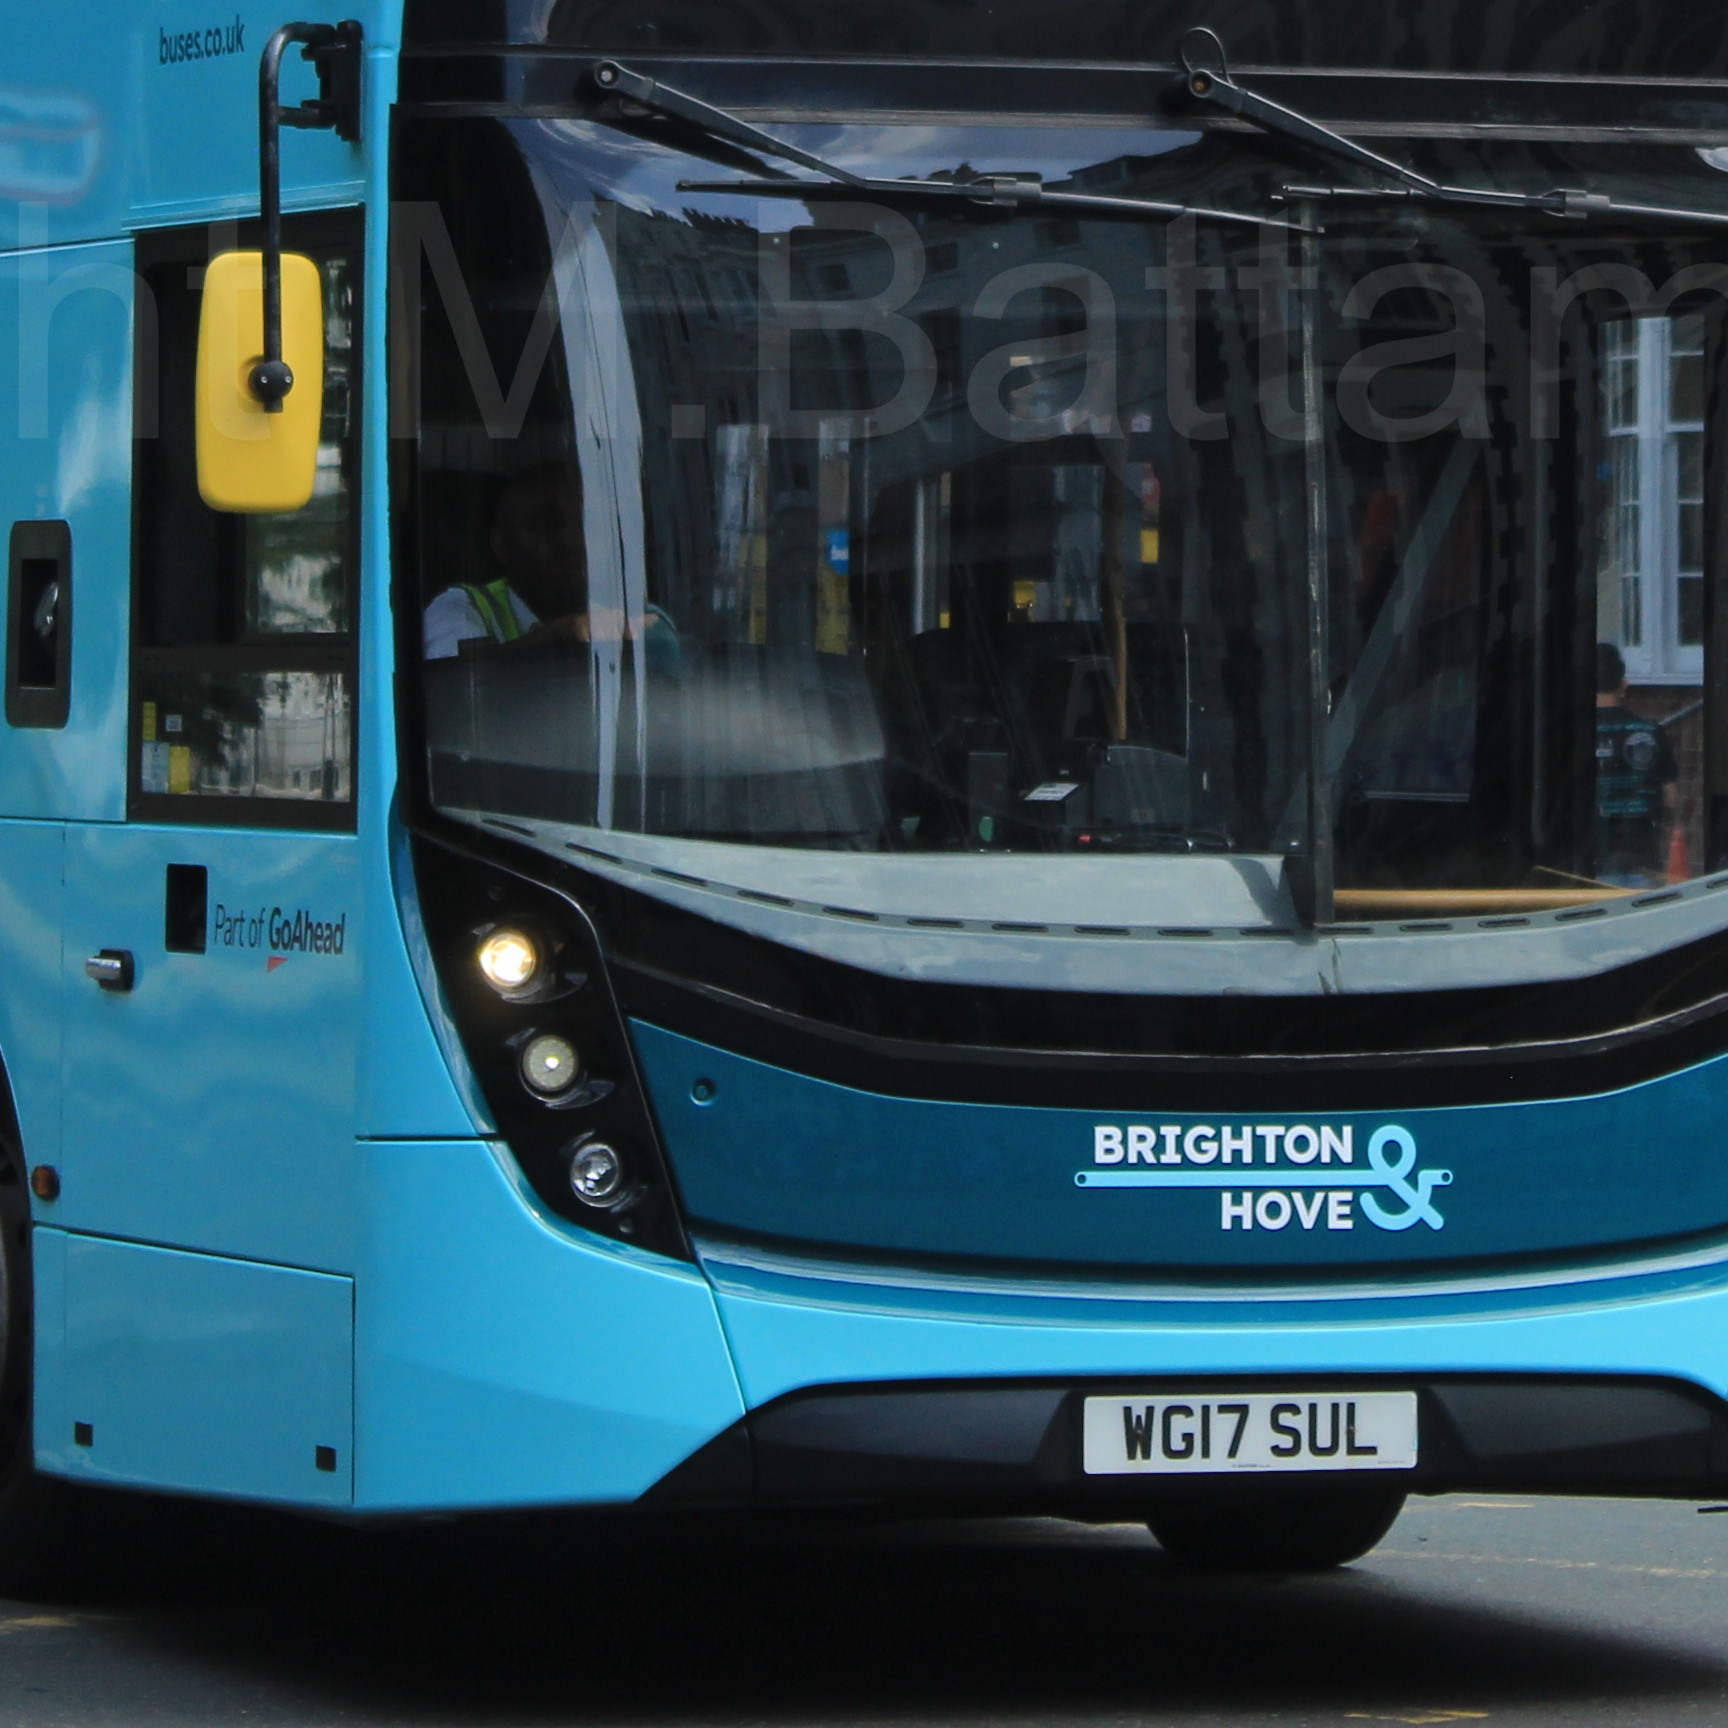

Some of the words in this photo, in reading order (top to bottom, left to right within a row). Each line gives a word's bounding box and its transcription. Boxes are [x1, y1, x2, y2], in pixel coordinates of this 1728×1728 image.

[159, 14, 245, 66] buses.co.uk
[214, 903, 245, 948] Part
[248, 907, 266, 948] of
[269, 906, 346, 956] GoAhead
[1094, 1125, 1354, 1165] BRIGHTON
[1220, 1191, 1354, 1231] HOVE
[1122, 1403, 1251, 1461] WG17
[1269, 1401, 1379, 1459] SUL
